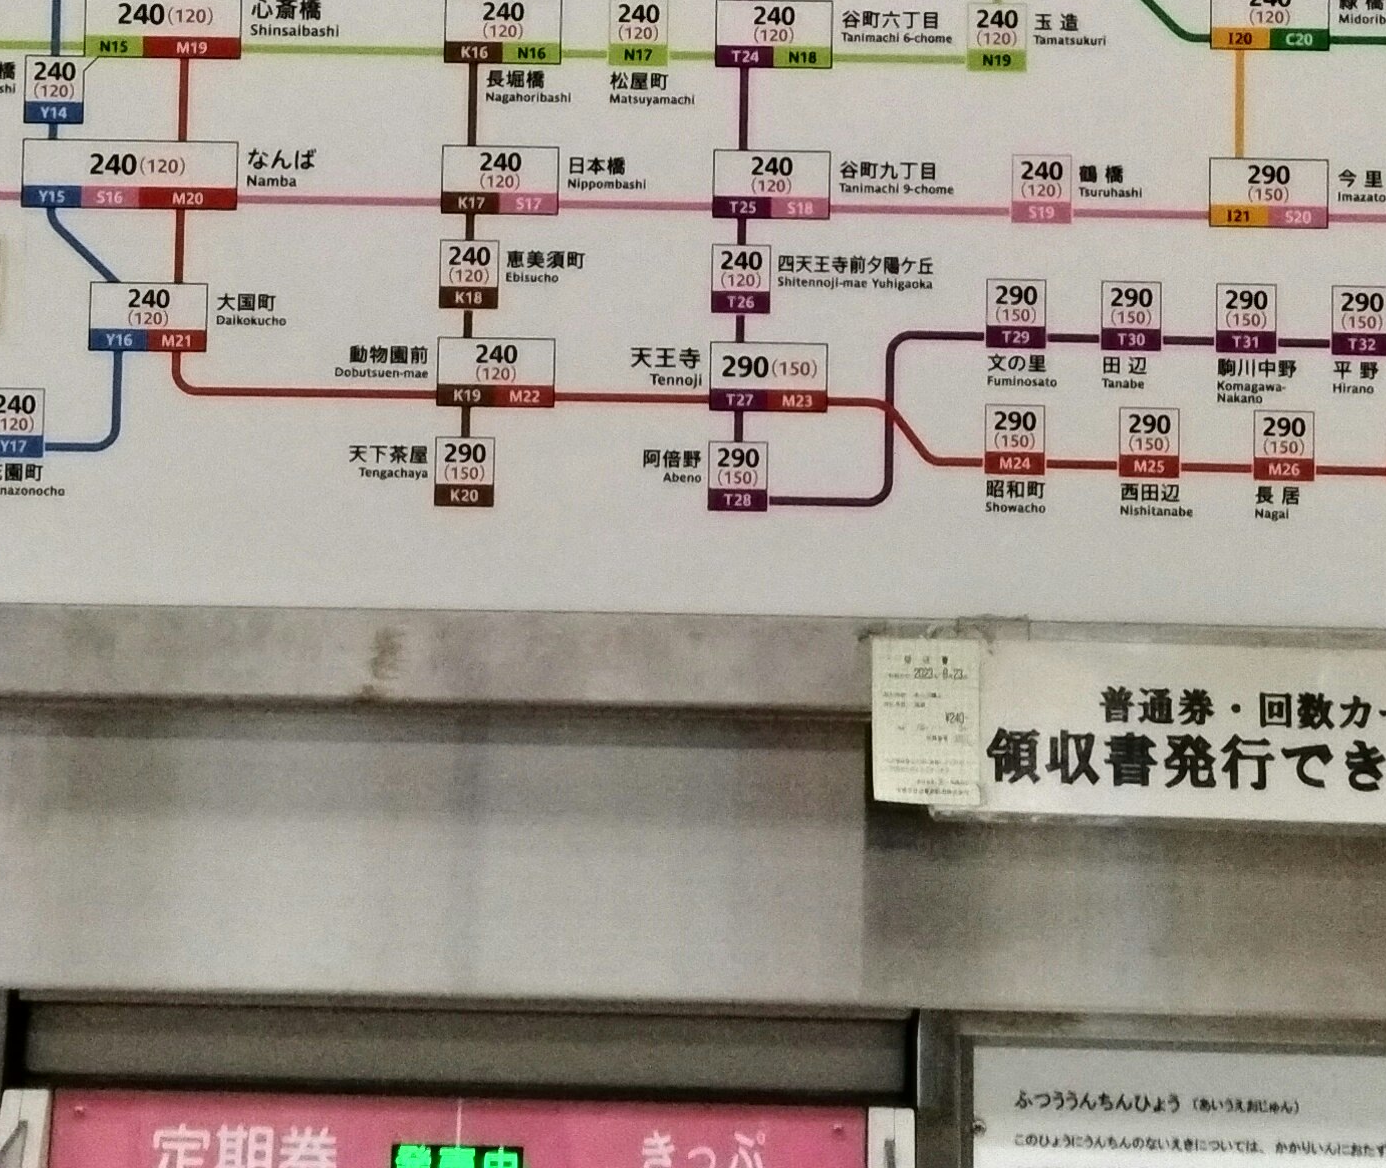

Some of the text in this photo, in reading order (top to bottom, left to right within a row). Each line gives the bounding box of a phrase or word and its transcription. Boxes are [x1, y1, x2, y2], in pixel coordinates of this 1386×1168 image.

[251, 24, 338, 37] Shinsaibashi
[248, 149, 316, 169] なんば
[247, 175, 296, 187] Namba
[778, 276, 932, 291] Shitennoji-mae Yuhigaoka
[218, 293, 275, 311] 大国町
[217, 315, 286, 326] Daikokucho
[632, 348, 700, 369] 天王寺
[650, 374, 702, 389] Tennoji
[1015, 1090, 1180, 1113] ふつううんちんひょう
[150, 1120, 339, 1168] 定期券
